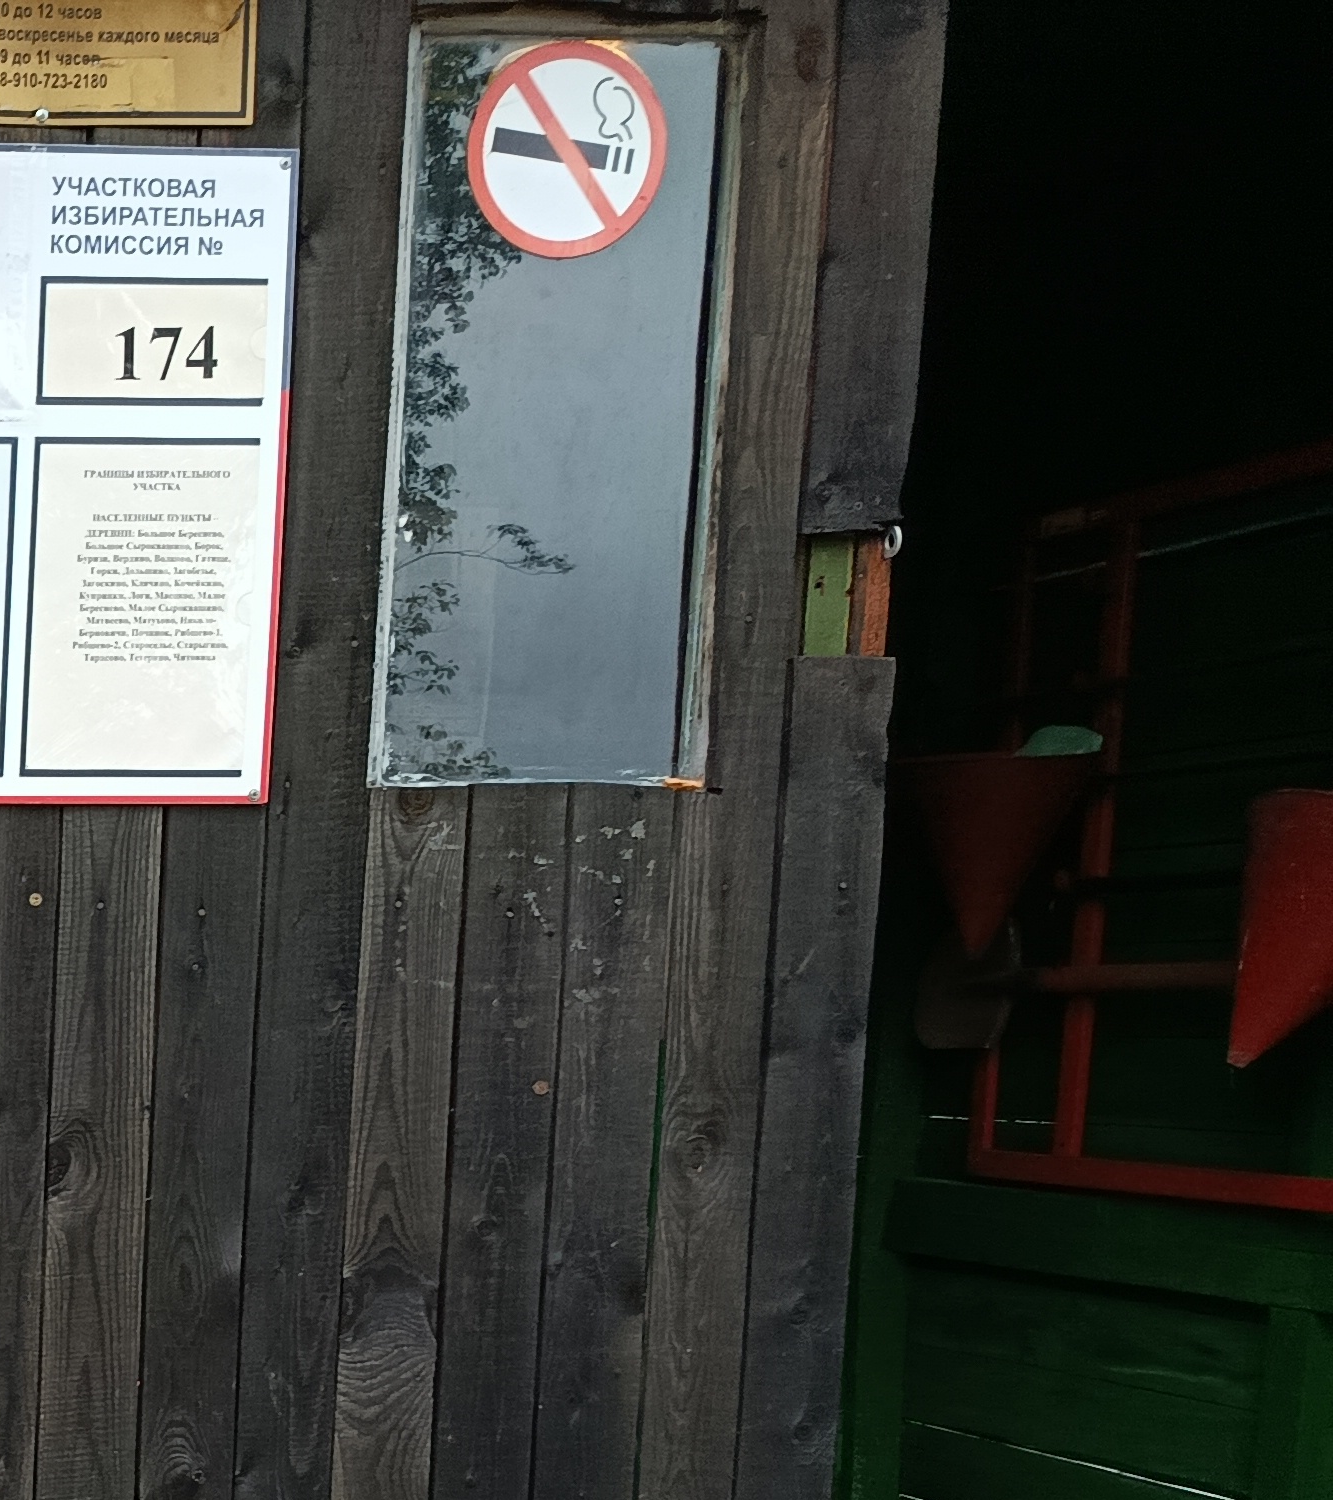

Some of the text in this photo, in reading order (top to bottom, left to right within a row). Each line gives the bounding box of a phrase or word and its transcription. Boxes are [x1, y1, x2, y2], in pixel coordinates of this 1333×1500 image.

[13, 6, 32, 20] до
[38, 3, 53, 18] 12
[58, 8, 102, 19] часов
[98, 31, 160, 45] каждого
[164, 29, 220, 45] месяца
[52, 176, 216, 198] УЧАСТКОВАЯ
[52, 205, 264, 227] ИЗБИРАТЕЛЬНАЯ
[51, 234, 223, 255] КОМИССИЯ №
[115, 326, 218, 380] 174
